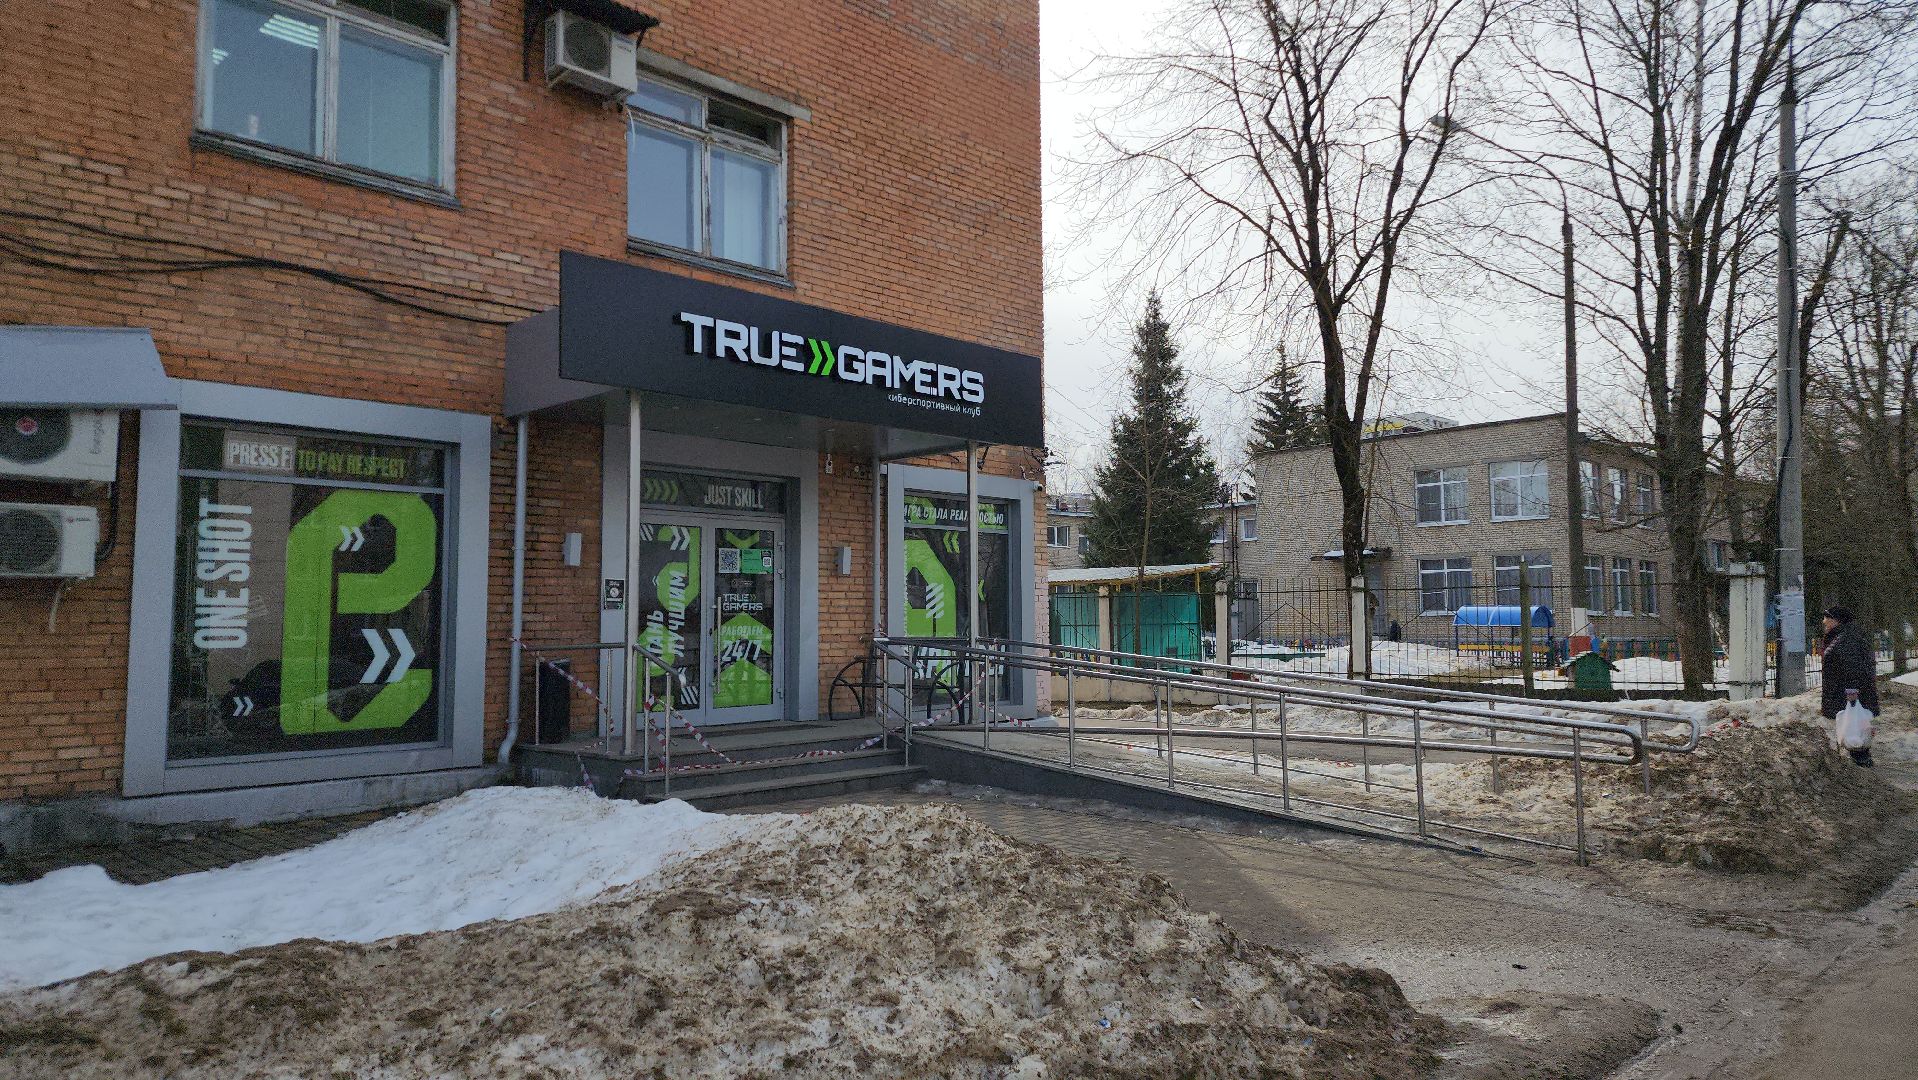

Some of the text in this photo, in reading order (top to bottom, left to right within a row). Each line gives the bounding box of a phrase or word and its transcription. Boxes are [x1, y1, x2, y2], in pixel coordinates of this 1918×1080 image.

[680, 311, 985, 403] TRUE GAMERS
[888, 393, 981, 418] киберспортивный клуб
[229, 442, 279, 467] PRESS
[298, 449, 406, 479] TO PAY RESPECT
[704, 484, 764, 509] JUST SKILL
[923, 506, 948, 520] СТАЛА
[950, 508, 1004, 525] РЕАЛОСТЬЮ
[194, 498, 253, 650] ONE SHOT
[722, 602, 763, 611] GAMERS
[723, 593, 750, 602] TRUE
[667, 570, 685, 658] ЛУЧШИМ
[647, 610, 665, 663] ТАНЬ
[721, 625, 763, 636] РАБОТАЕМ
[721, 639, 762, 662] 24/7
